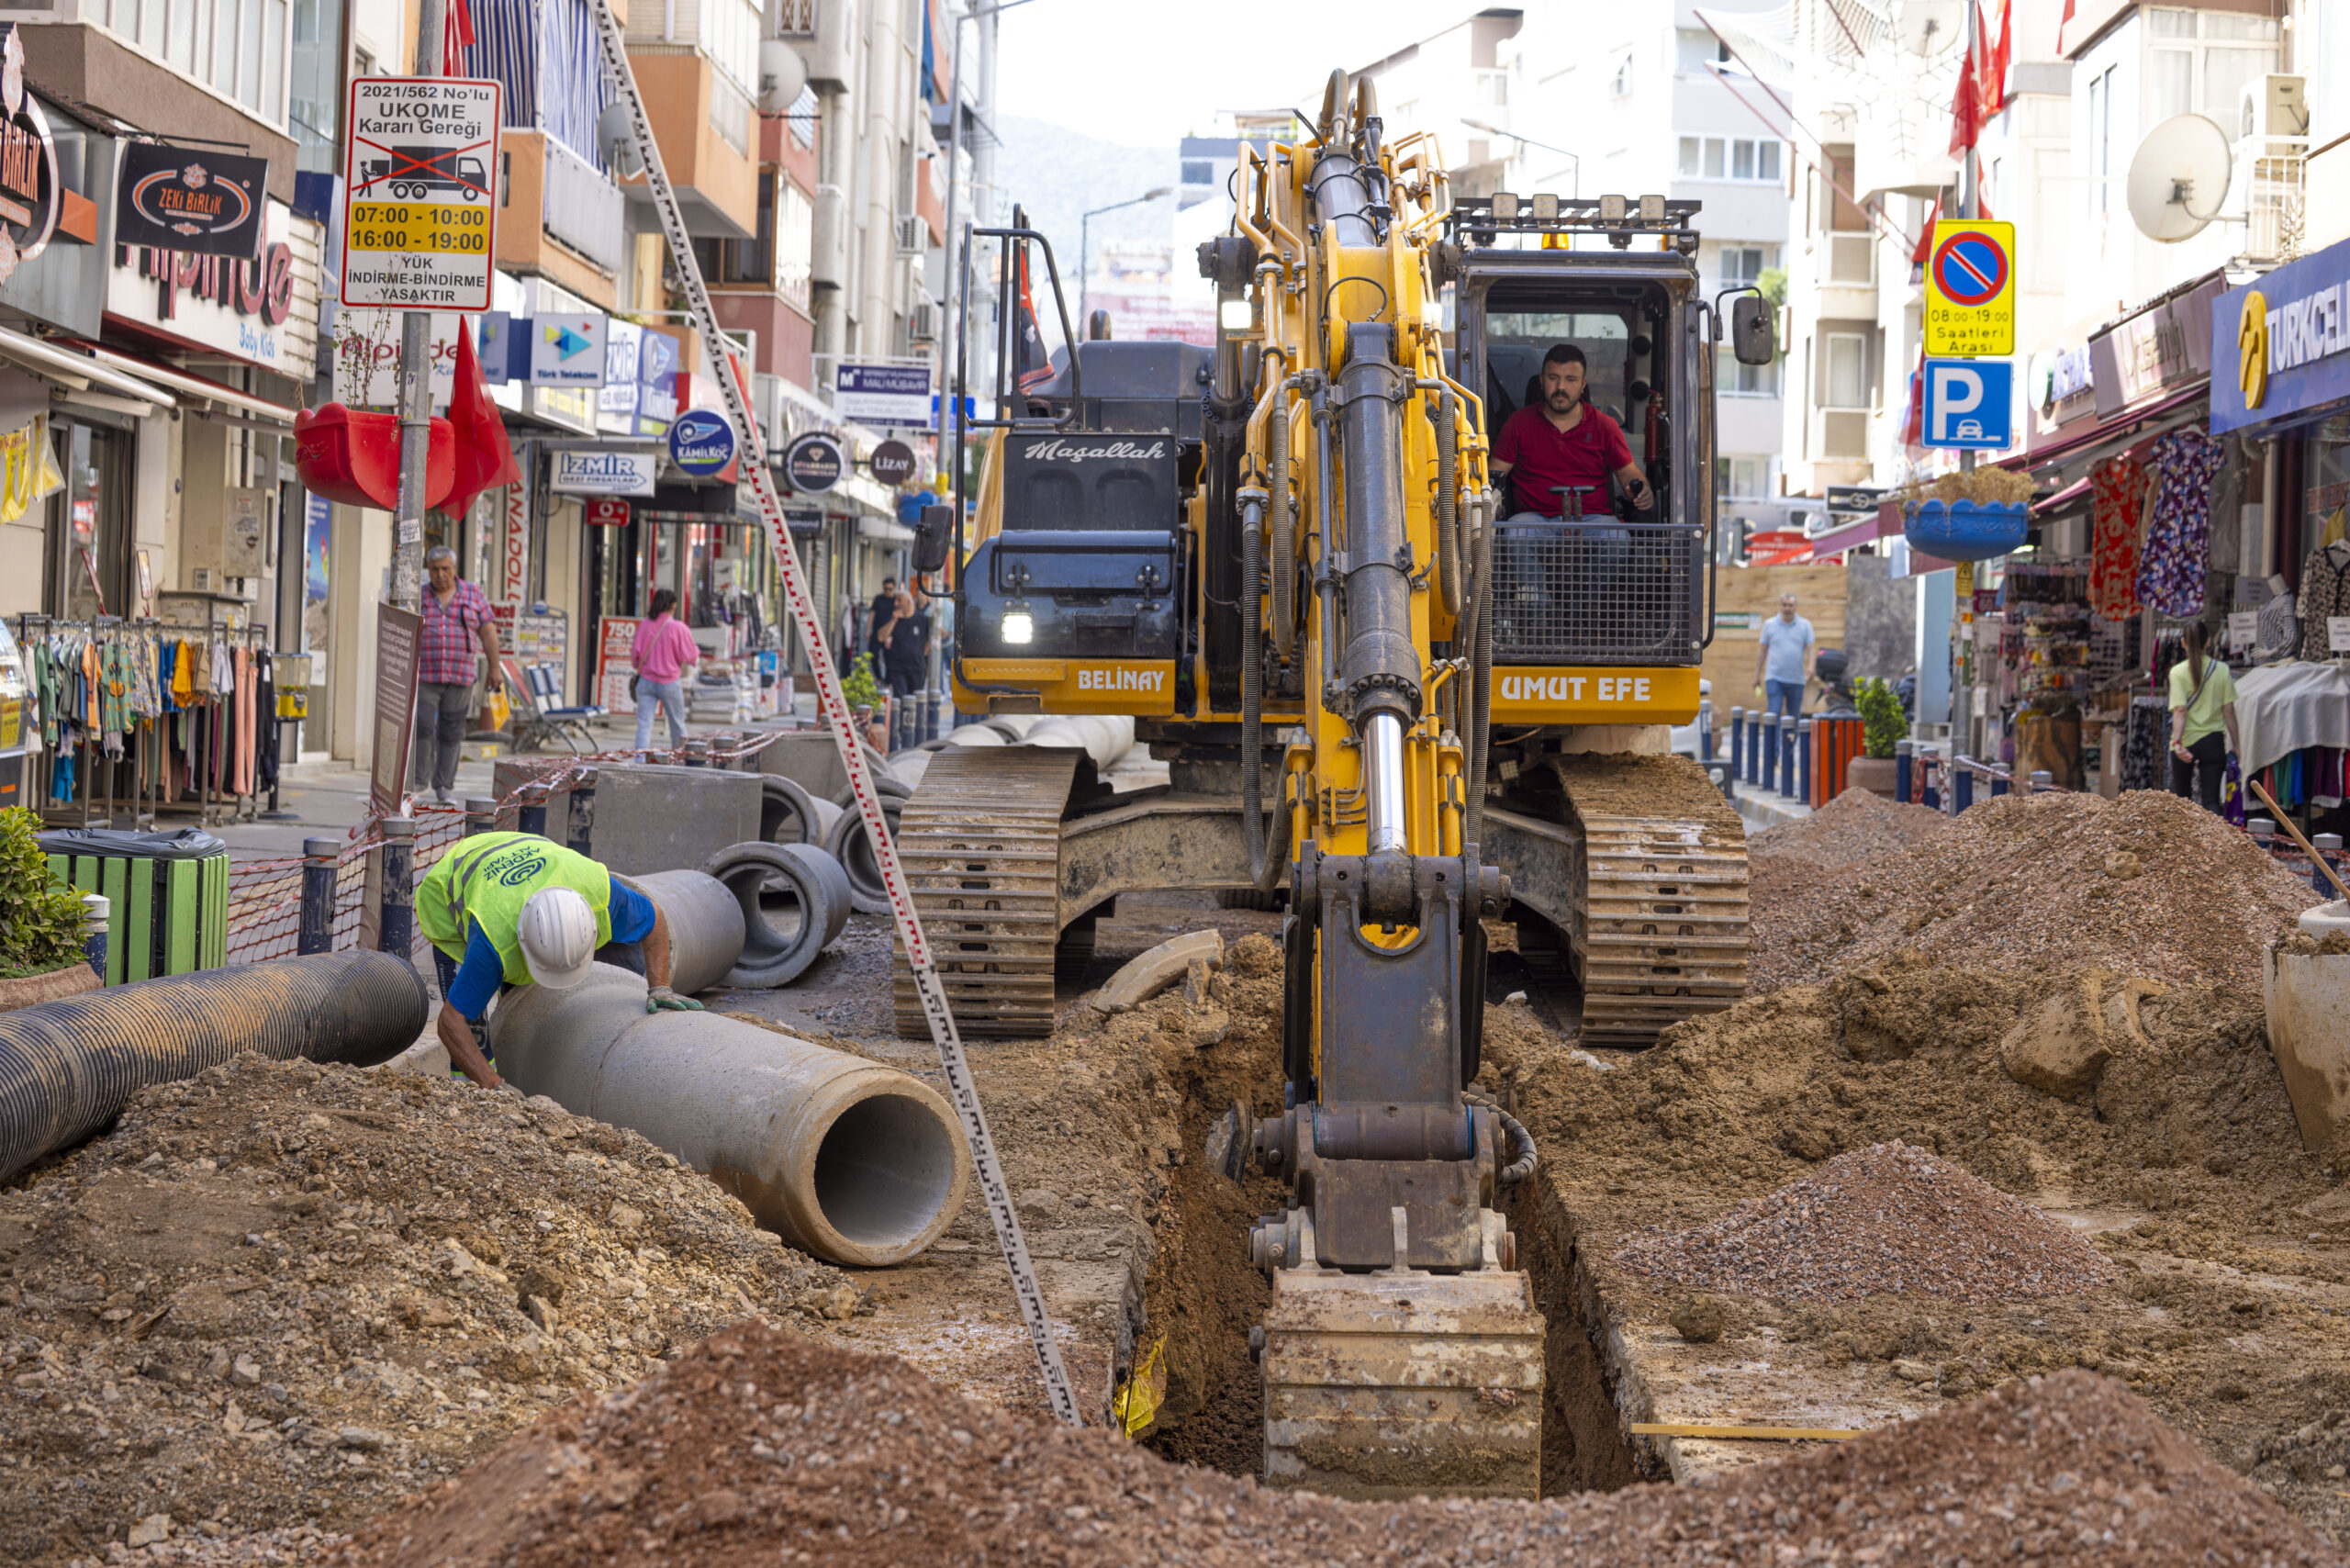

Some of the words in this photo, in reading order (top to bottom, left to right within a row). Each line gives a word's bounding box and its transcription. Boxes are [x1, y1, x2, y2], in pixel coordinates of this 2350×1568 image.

[362, 85, 438, 98] 2021/562
[379, 102, 465, 120] UKOME
[359, 118, 414, 134] Kararı
[420, 118, 481, 140] Gereği
[354, 207, 408, 224] 07:00
[430, 208, 484, 226] 10:00
[352, 230, 407, 248] 16:00
[428, 231, 484, 251] 19:00
[402, 255, 433, 269] YÜK
[348, 269, 486, 287] İNDİRME-BİNDİRME
[380, 288, 455, 302] YASAKTIR
[240, 322, 259, 359] Baby
[260, 331, 275, 359] Kids
[1936, 326, 2005, 339] Saatleri
[1949, 341, 1994, 353] Arası
[537, 369, 556, 379] Türk
[560, 370, 599, 380] Telekom
[1024, 439, 1166, 463] Maşallah
[561, 452, 636, 476] İZMİR
[607, 622, 635, 639] 750
[1078, 666, 1165, 692] BELİNAY
[1501, 677, 1587, 700] UMUT
[1597, 678, 1651, 701] EFE
[992, 1182, 1004, 1202] 25
[1023, 1275, 1035, 1293] 23
[1029, 1321, 1042, 1339] 22
[1051, 1365, 1064, 1383] 21
